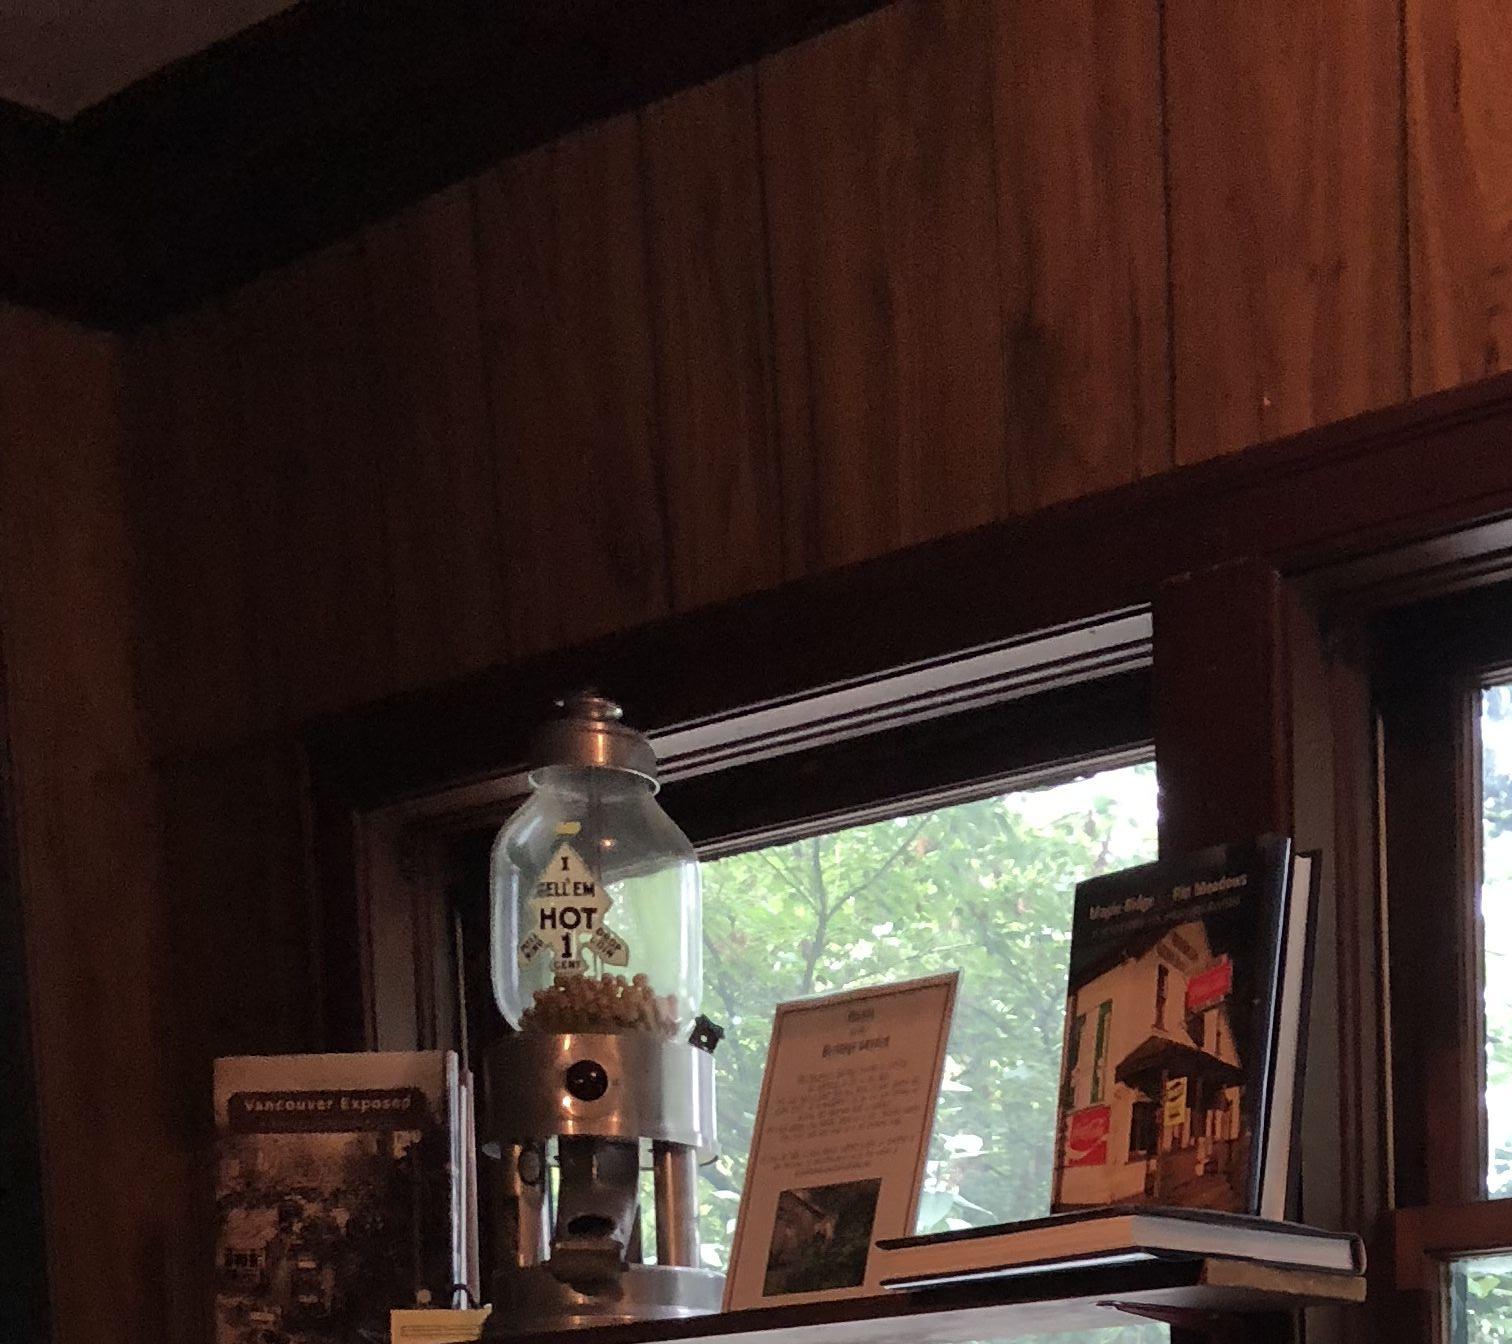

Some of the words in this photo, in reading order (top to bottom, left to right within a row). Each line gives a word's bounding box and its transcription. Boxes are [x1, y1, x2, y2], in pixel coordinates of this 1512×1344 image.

[561, 856, 570, 871] I
[540, 906, 598, 930] HOT
[561, 932, 573, 959] 1
[244, 1098, 334, 1112] Vancouver
[340, 1095, 412, 1113] Exposed
